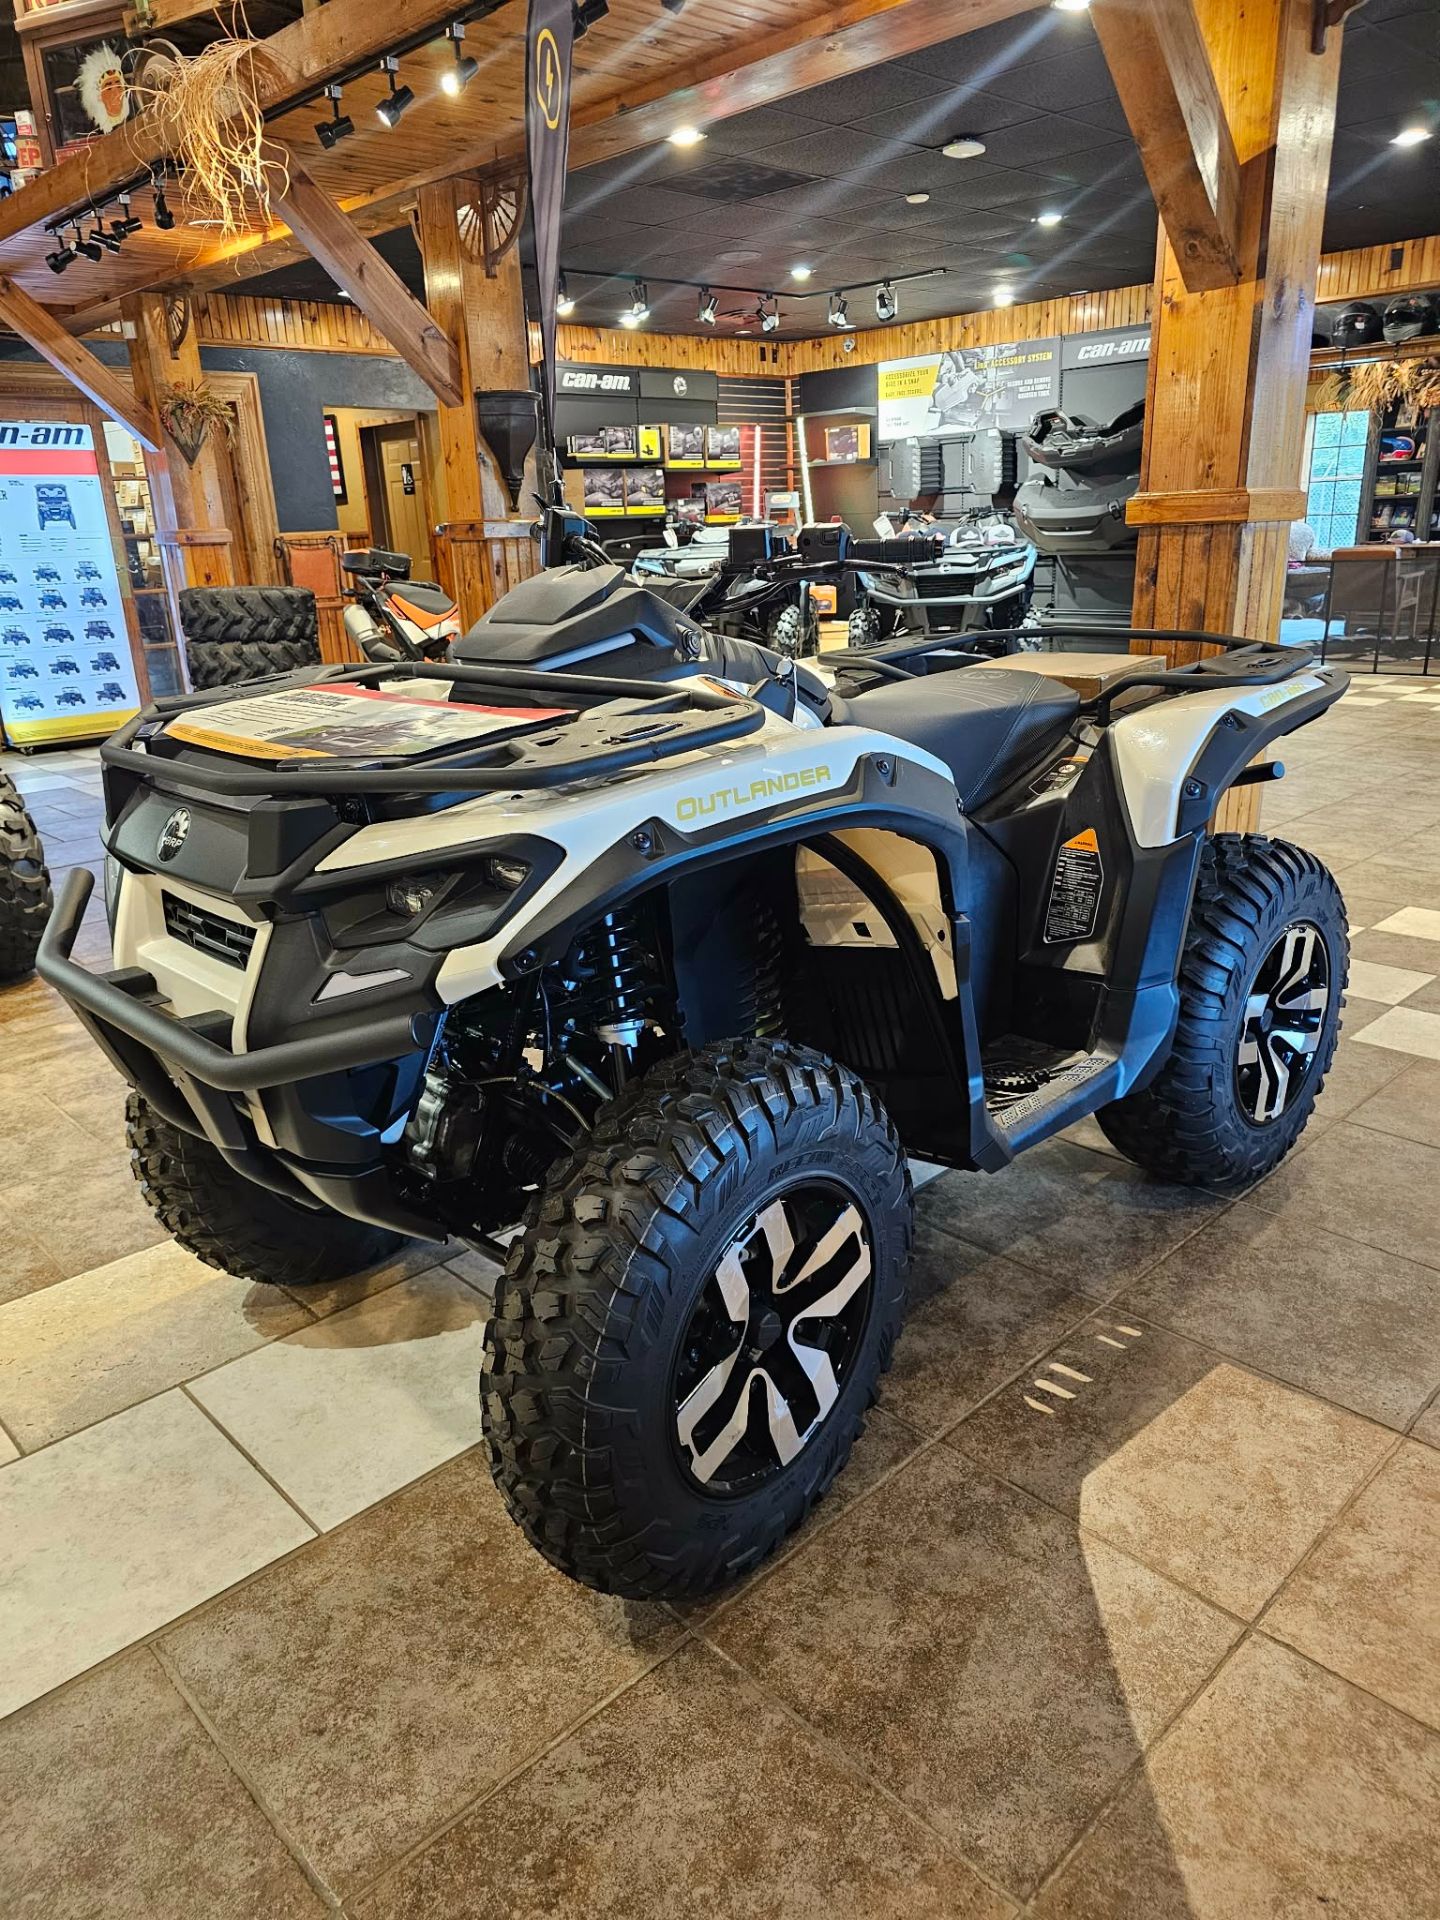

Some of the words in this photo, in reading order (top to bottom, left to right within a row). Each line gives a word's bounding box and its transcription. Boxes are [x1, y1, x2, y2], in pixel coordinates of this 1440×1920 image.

[1078, 338, 1151, 360] can-am
[991, 355, 1025, 368] ACCESSORY
[1027, 351, 1053, 363] SYSTEM
[562, 372, 630, 391] can-am
[676, 765, 832, 821] OUTLANDER
